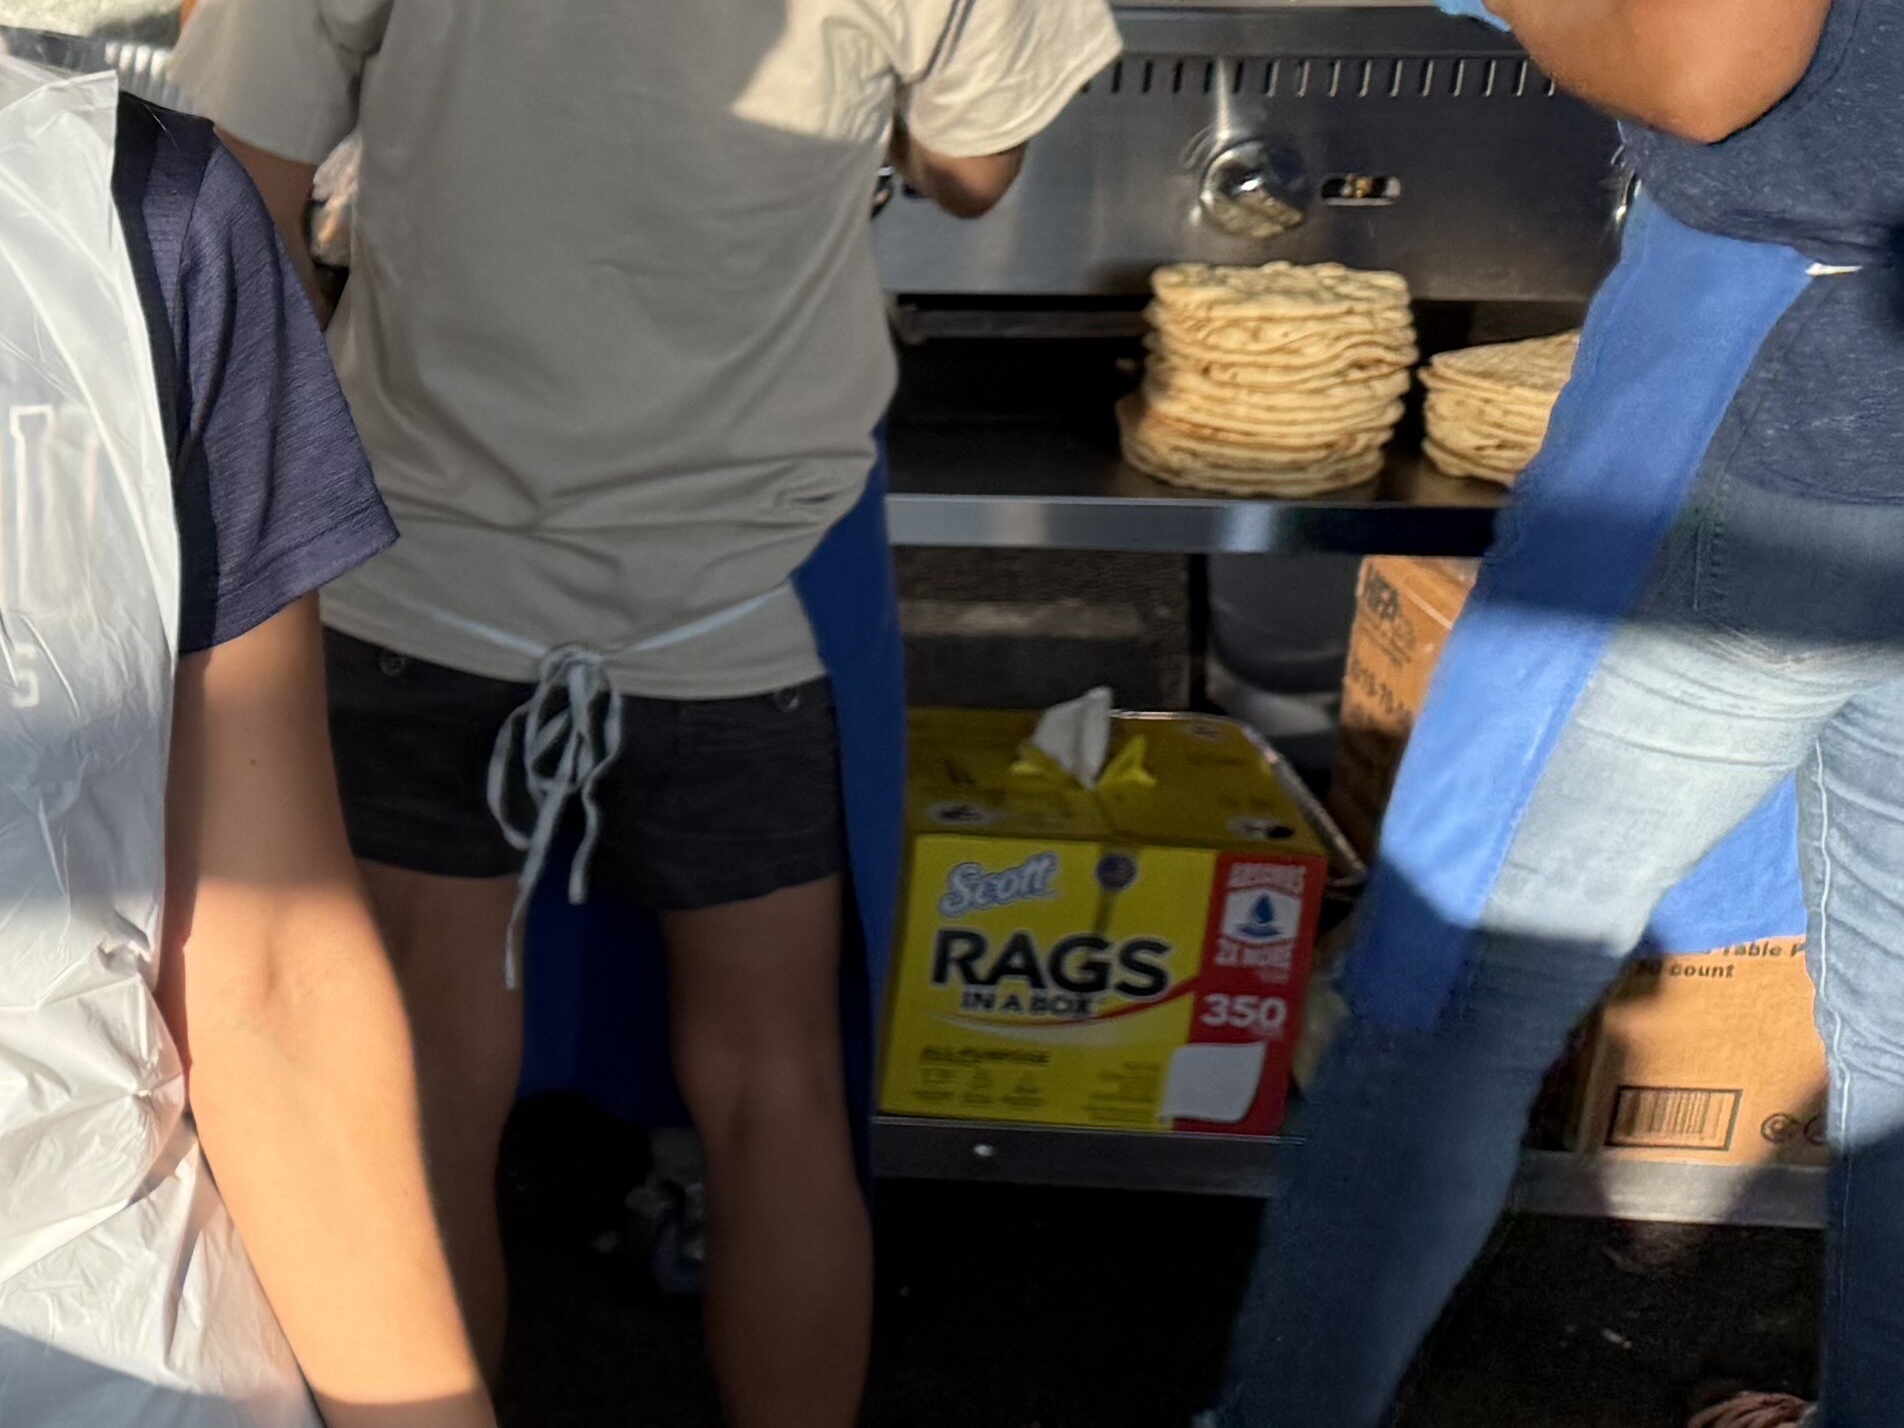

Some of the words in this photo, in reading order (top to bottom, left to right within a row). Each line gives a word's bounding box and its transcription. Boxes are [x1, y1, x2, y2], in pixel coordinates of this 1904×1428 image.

[938, 851, 1061, 919] Scott
[931, 927, 1173, 999] RAGS
[1669, 961, 1735, 979] count
[1201, 993, 1288, 1028] 350
